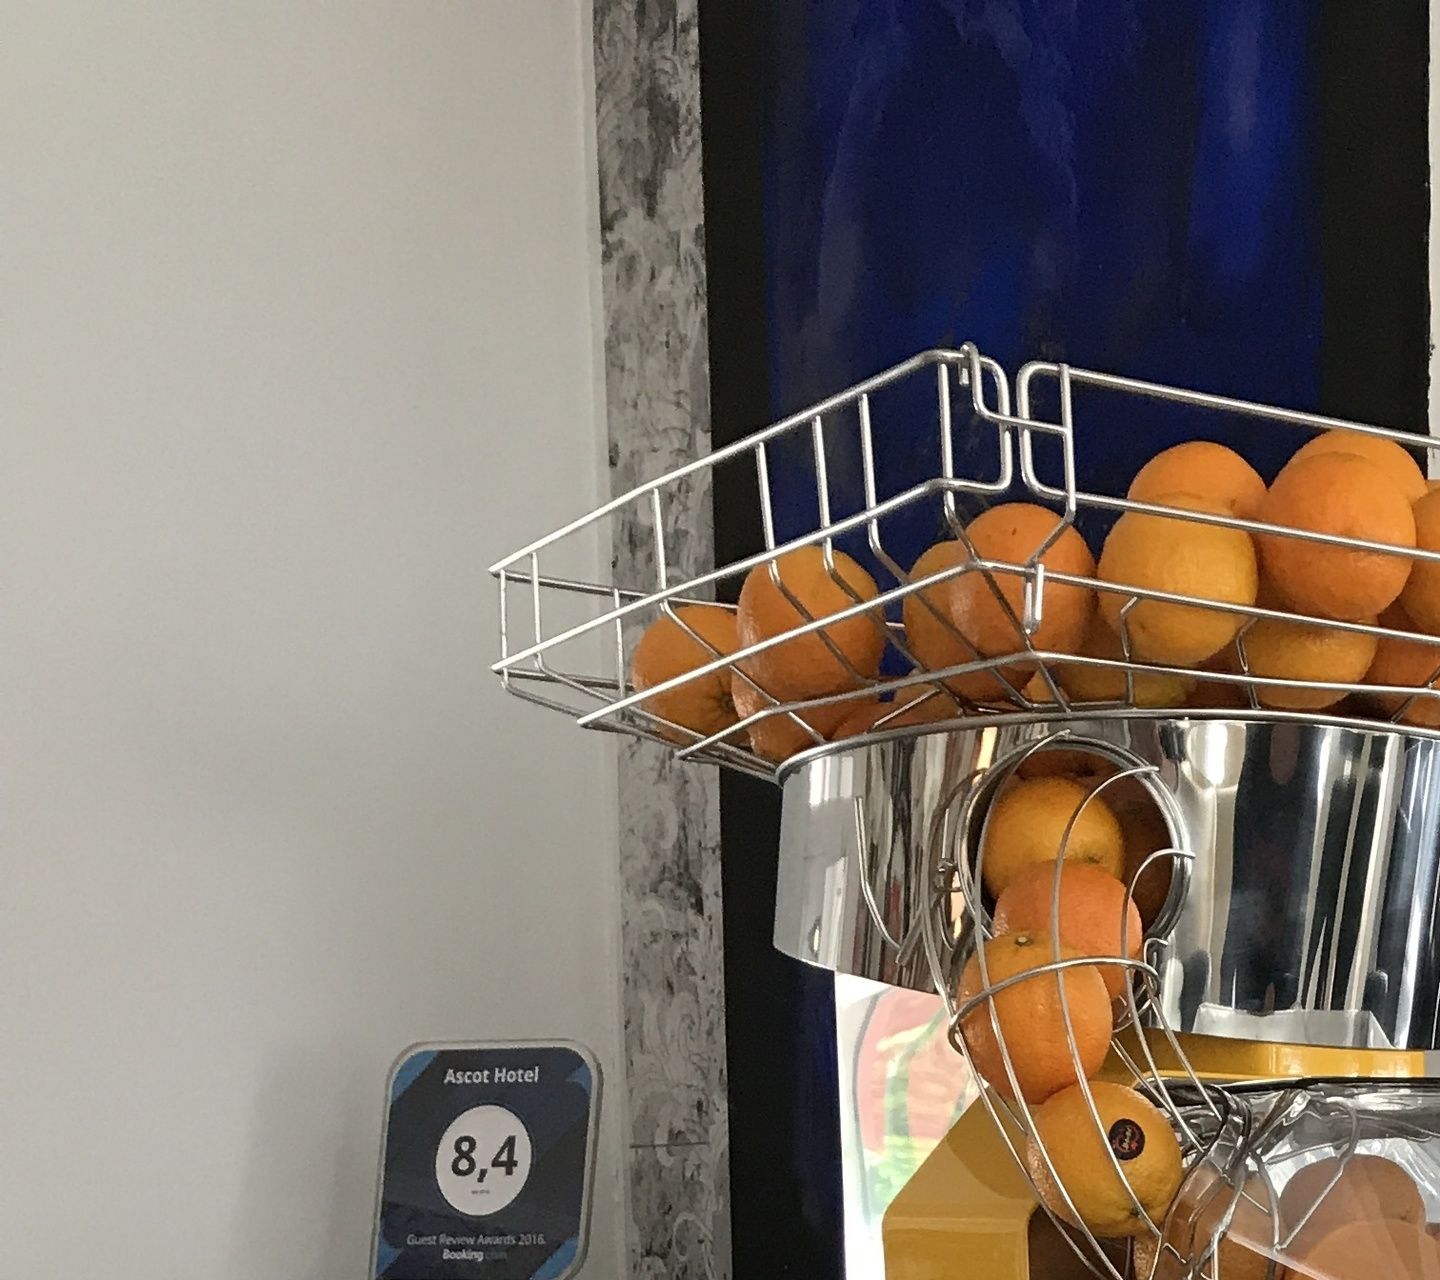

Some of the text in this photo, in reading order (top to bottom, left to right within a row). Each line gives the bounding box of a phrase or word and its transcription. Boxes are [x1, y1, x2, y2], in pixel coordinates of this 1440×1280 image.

[444, 1066, 540, 1084] Ascot Hotel
[451, 1135, 518, 1183] 8,4
[406, 1234, 437, 1245] Guest
[439, 1234, 475, 1245] Review
[477, 1234, 516, 1245] Awards
